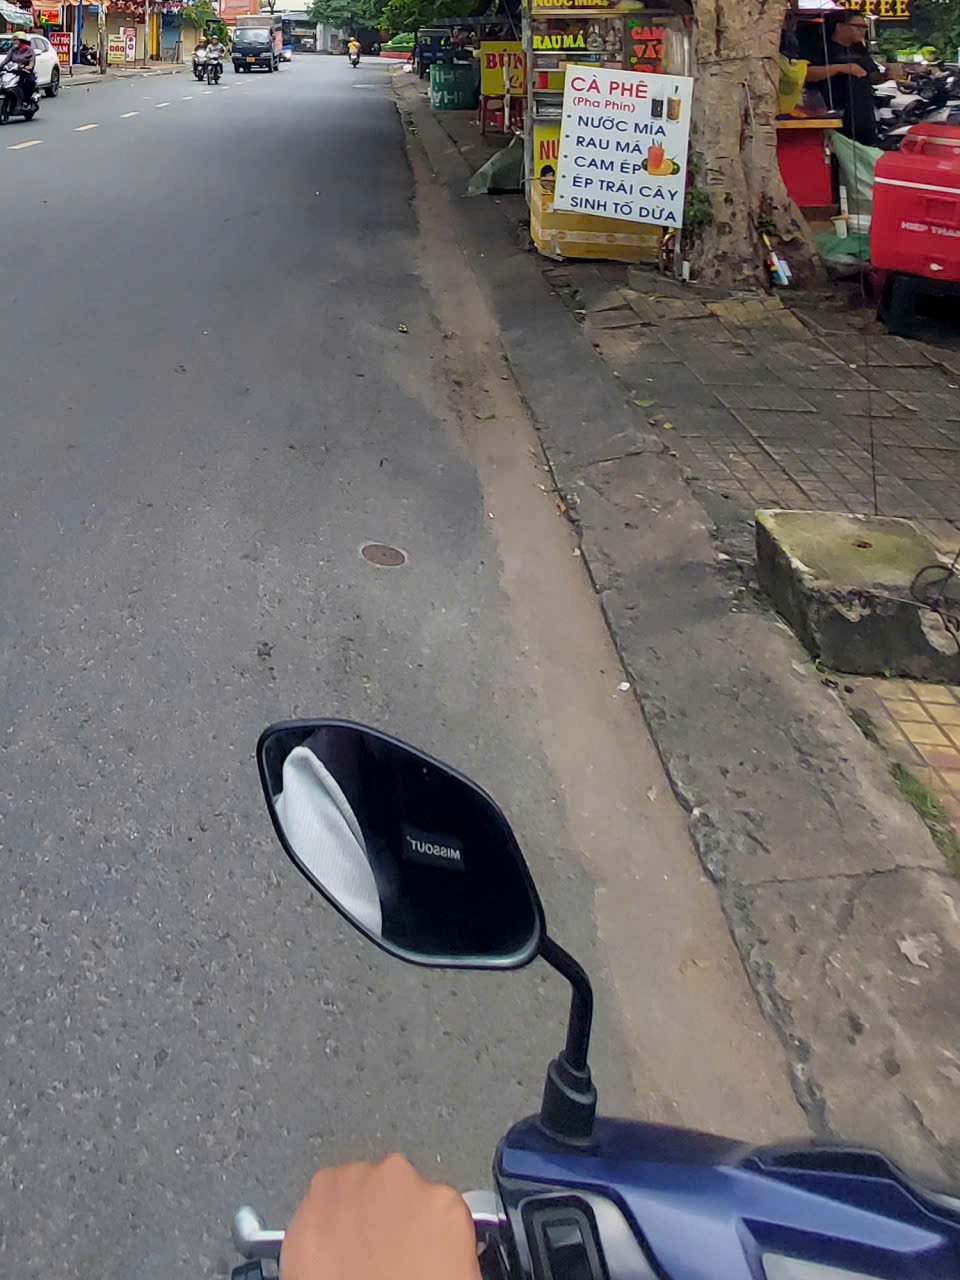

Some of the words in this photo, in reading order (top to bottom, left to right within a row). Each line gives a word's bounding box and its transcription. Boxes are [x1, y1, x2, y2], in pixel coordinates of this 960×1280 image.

[533, 35, 561, 49] RAU
[563, 30, 586, 48] MÁ
[570, 74, 600, 94] CÀ
[609, 80, 648, 99] PHÊ
[572, 96, 601, 109] (Pha
[604, 99, 636, 113] Phin)
[577, 114, 629, 133] NƯỚC
[633, 121, 667, 137] MÍA
[576, 135, 610, 150] RAU
[615, 139, 643, 155] MÁ
[574, 156, 615, 171] CAM
[620, 159, 642, 175] ÉP
[572, 173, 594, 189] ÉP
[598, 179, 633, 196] TRÁI
[639, 185, 679, 202] CÂY
[570, 196, 607, 212] SINH
[613, 201, 634, 216] TỐ
[639, 204, 677, 223] DỪA
